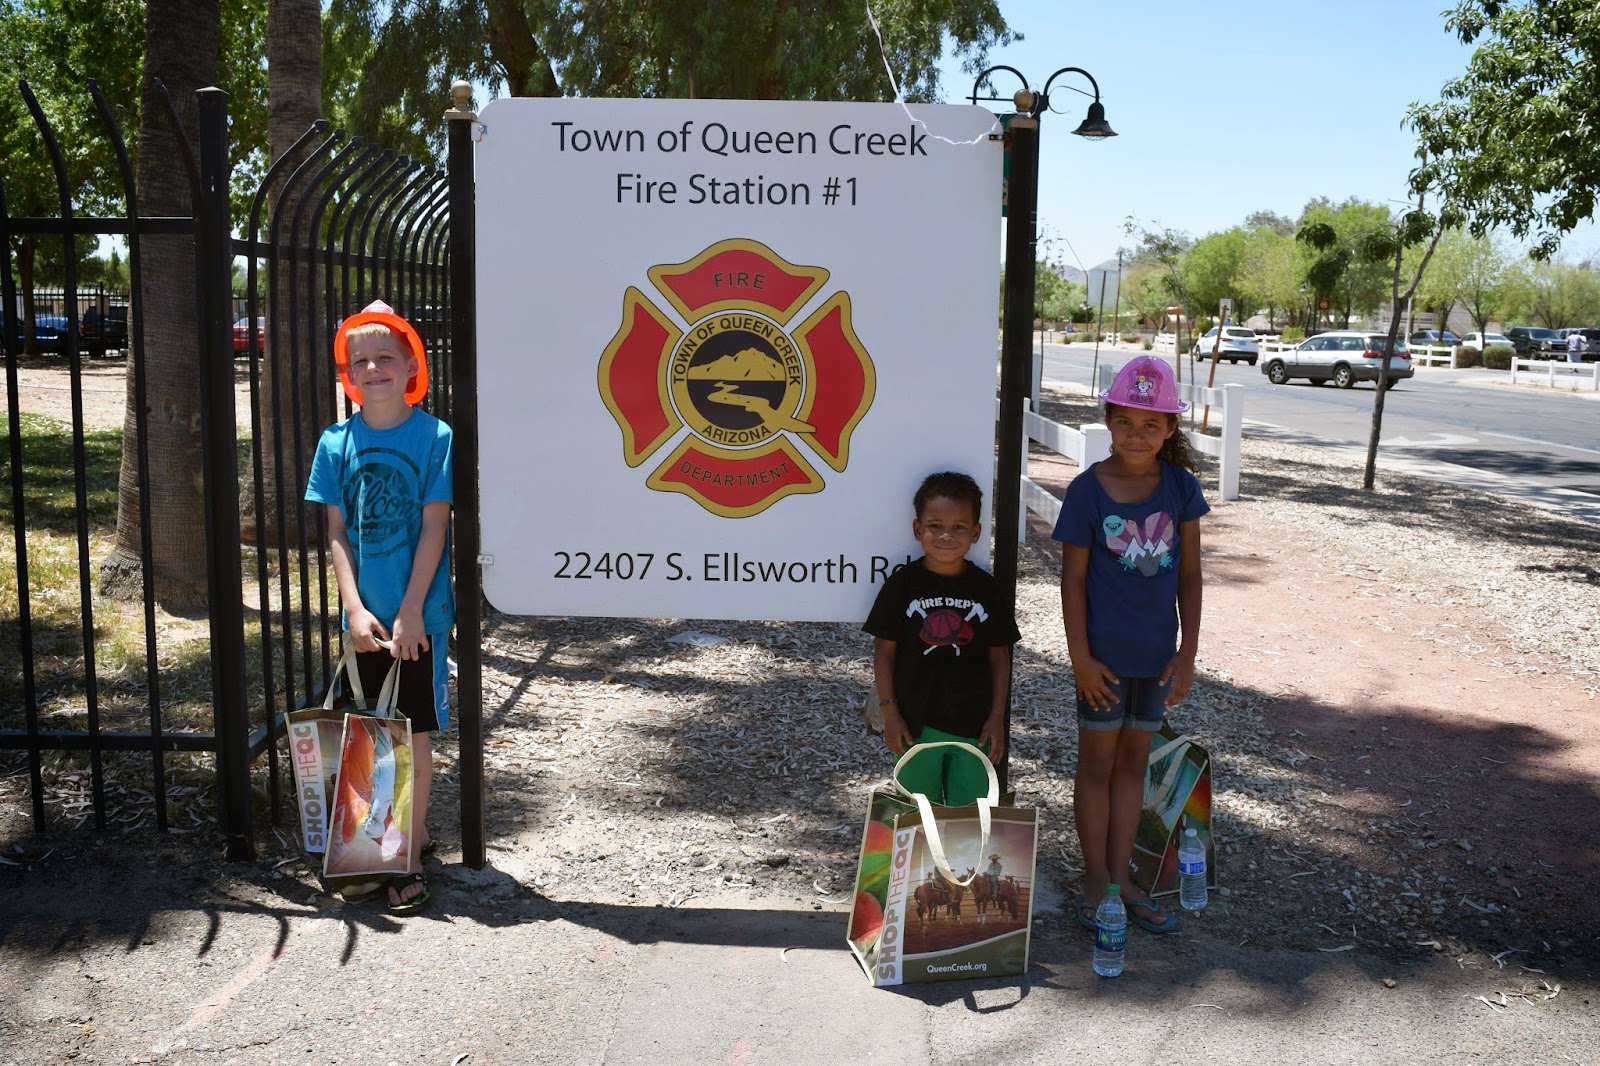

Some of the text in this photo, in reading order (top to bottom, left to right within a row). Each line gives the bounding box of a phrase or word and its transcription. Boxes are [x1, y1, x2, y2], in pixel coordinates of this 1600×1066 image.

[551, 121, 928, 157] Town of Queen Creek
[617, 173, 858, 206] Fire Station #1
[713, 272, 767, 290] FIRE
[673, 317, 801, 387] TOWN OF QUEEN CREEK
[702, 424, 772, 444] ARIZONA
[680, 461, 792, 488] DEPARTMENT
[553, 551, 655, 580] 22407
[666, 552, 692, 581] S.
[704, 552, 858, 583] Ellsworth
[917, 596, 944, 610] IRE
[926, 961, 988, 974] QueenCreek.org
